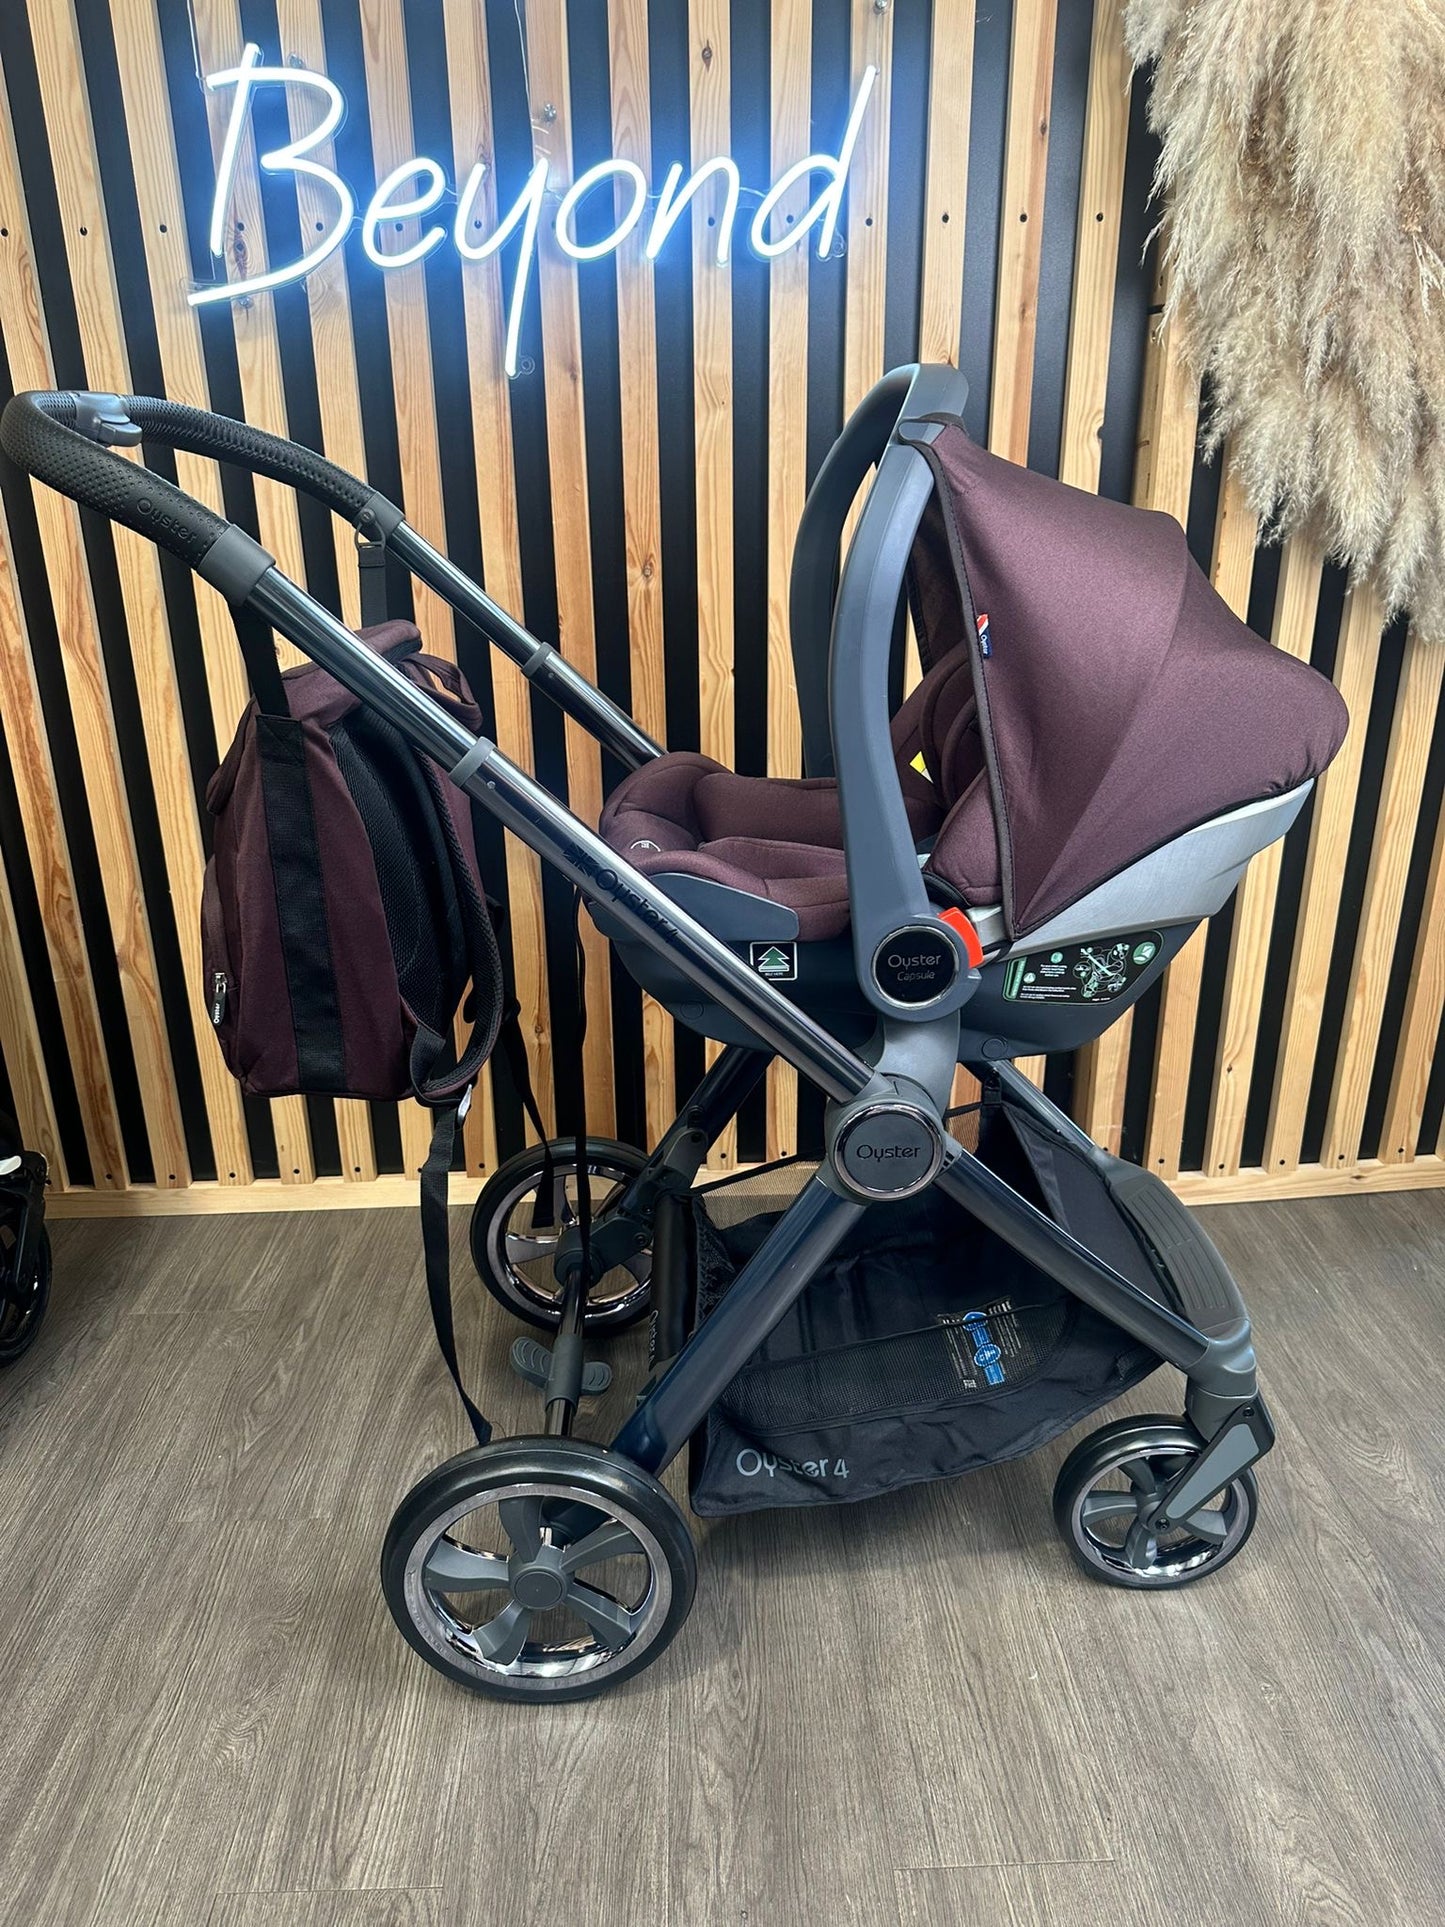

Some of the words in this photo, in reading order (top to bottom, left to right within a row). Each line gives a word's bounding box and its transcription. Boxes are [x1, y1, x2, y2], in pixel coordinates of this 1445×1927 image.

[187, 42, 877, 377] Beyond
[136, 497, 198, 544] Oyster
[595, 868, 669, 932] Oyster
[887, 954, 941, 970] Oyster
[897, 970, 936, 982] Capsule
[856, 1144, 921, 1163] Oyster
[736, 1448, 829, 1478] Oyster
[833, 1458, 850, 1479] 4
